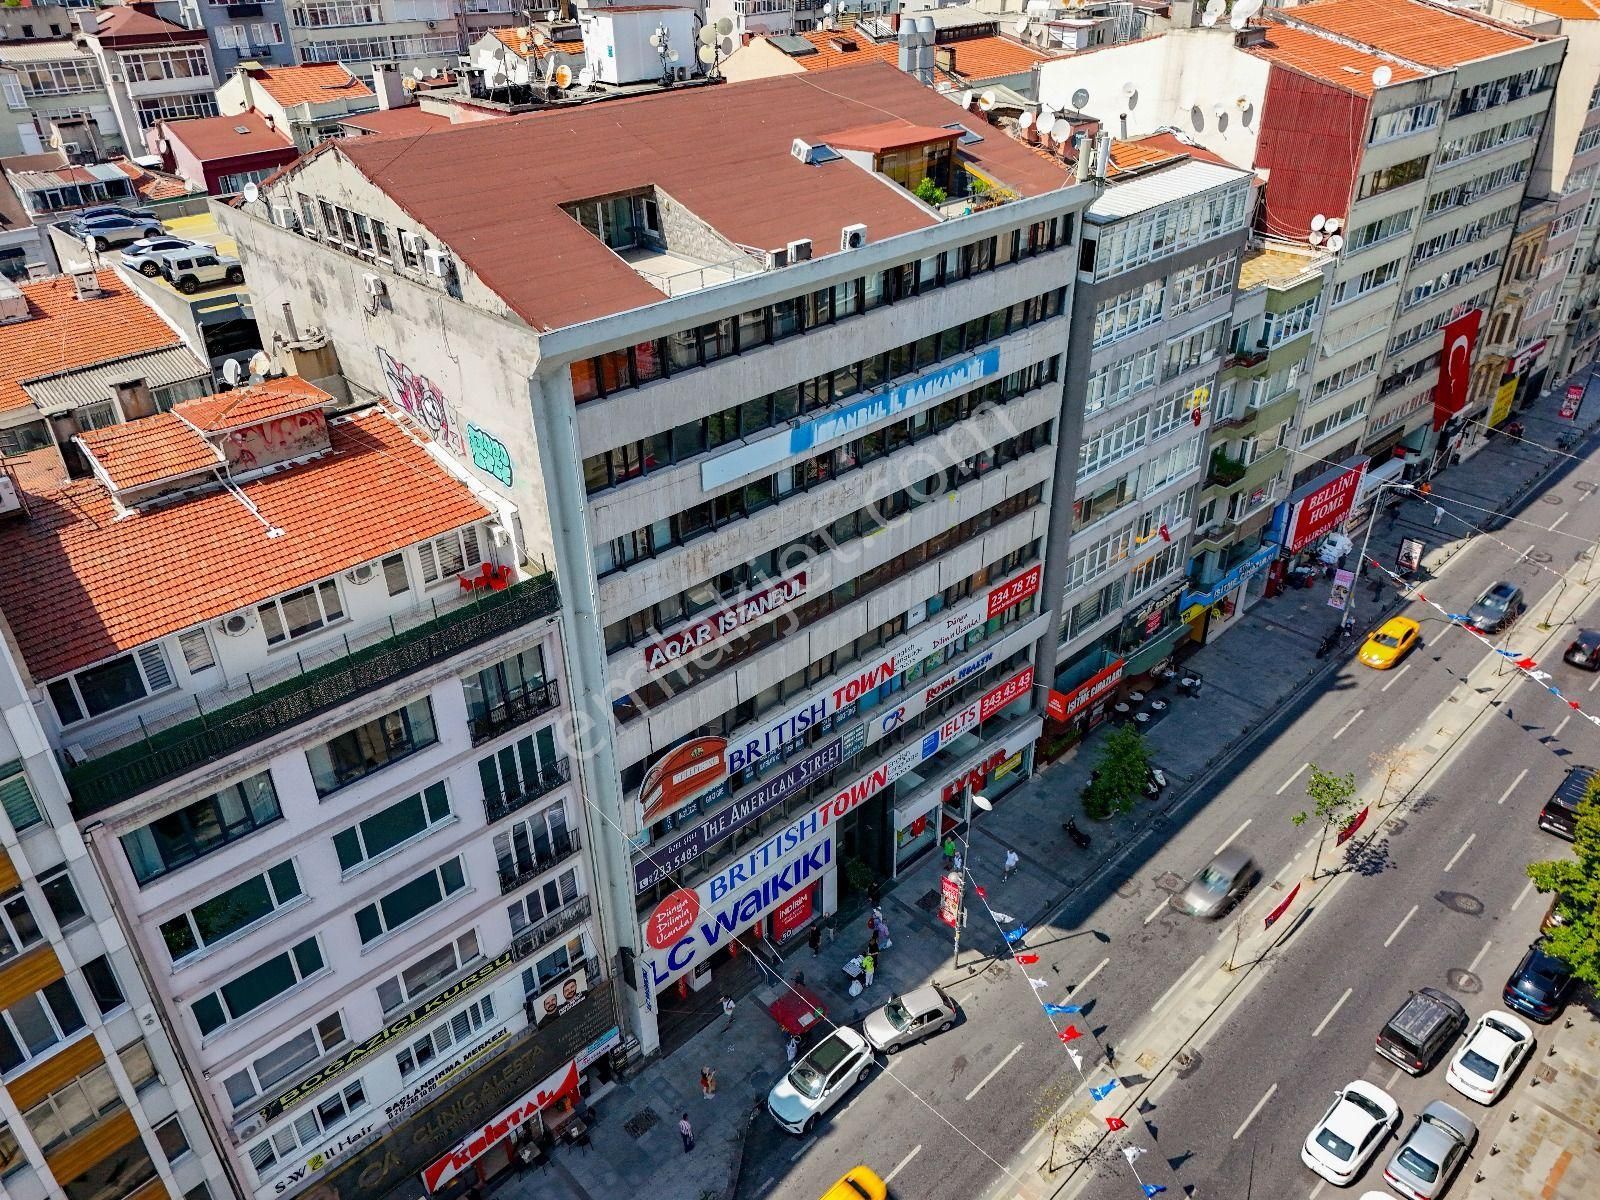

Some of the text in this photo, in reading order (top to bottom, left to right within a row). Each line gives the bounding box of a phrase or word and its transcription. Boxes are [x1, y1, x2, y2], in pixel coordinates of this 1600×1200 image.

[1309, 493, 1346, 525] HOME
[991, 571, 1037, 608] 234 78 78
[649, 624, 712, 669] AQAR
[982, 672, 1030, 712] 343 43 43
[729, 697, 827, 774] BRITISH
[832, 657, 895, 710] TOWN
[941, 705, 976, 741] IELTS
[700, 815, 725, 842] THE
[730, 771, 795, 825] AMERICAN
[800, 742, 840, 779] STREET
[709, 811, 817, 904] BRITISH
[819, 764, 888, 827] TOWN
[674, 844, 698, 870] 5483
[656, 899, 689, 923] Dünya
[651, 936, 696, 986] LC
[278, 1011, 417, 1107] BOĞAZİÇİ
[424, 951, 511, 1013] KURSU
[463, 1026, 509, 1062] MERKEZİ
[337, 1121, 375, 1152] Hair
